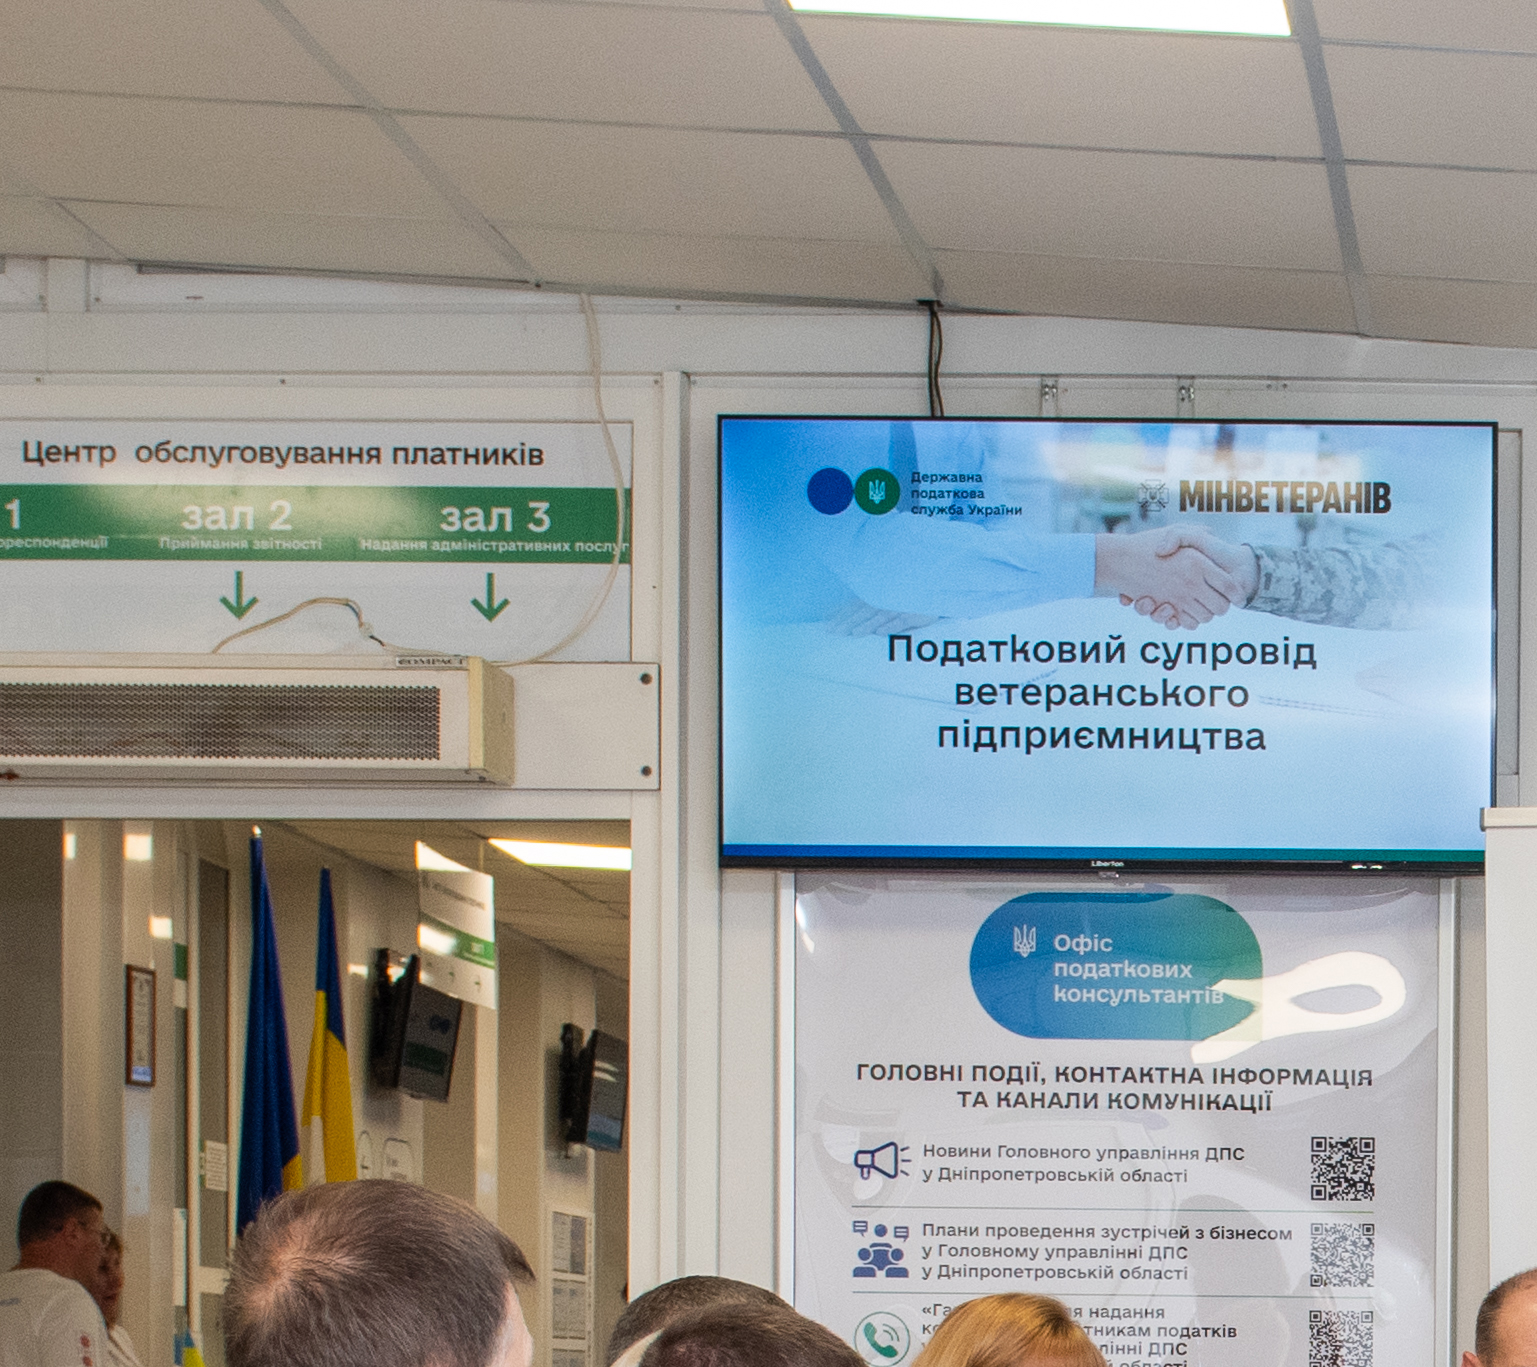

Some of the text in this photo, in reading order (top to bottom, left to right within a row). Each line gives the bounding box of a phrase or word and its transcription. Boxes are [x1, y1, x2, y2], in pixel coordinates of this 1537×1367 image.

[22, 440, 545, 469] Центр обслуговування платників
[911, 471, 983, 486] Державна
[911, 487, 985, 501] податкова
[1179, 480, 1392, 514] МІНВЕТЕРАНІВ
[4, 499, 21, 530] 1
[181, 499, 293, 531] зал 2
[440, 500, 552, 533] зал 3
[911, 502, 1023, 517] служба України
[159, 536, 249, 550] Приймання
[361, 538, 428, 553] Надання
[433, 539, 571, 554] адміністративних
[888, 634, 1317, 671] Податковий супровід
[955, 678, 1249, 712] ветеранського
[938, 719, 1266, 755] підприємництва
[1054, 933, 1113, 955] Офіс
[1054, 958, 1193, 981] податкових
[1054, 983, 1224, 1008] консультантів
[857, 1061, 1373, 1091] ГОЛОВНІ ПОДІЇ, КОНТАКТНА ІНФОРМАЦІЯ
[956, 1091, 1274, 1115] ТА КАНАЛИ КОМУНІКАЦІЇ
[923, 1144, 1246, 1163] Новини Головного управління ДПС
[922, 1166, 1188, 1184] у Дніпропетровській області
[922, 1223, 1293, 1242] Плани проведення зустрічей з бізнесом
[922, 1244, 1188, 1262] у Головному управлінні ДПС
[921, 1264, 1189, 1282] у Дніпропетровській області
[1089, 1307, 1165, 1321] надання
[1083, 1323, 1238, 1340] тникам податків
[1148, 1342, 1188, 1358] ДПС
